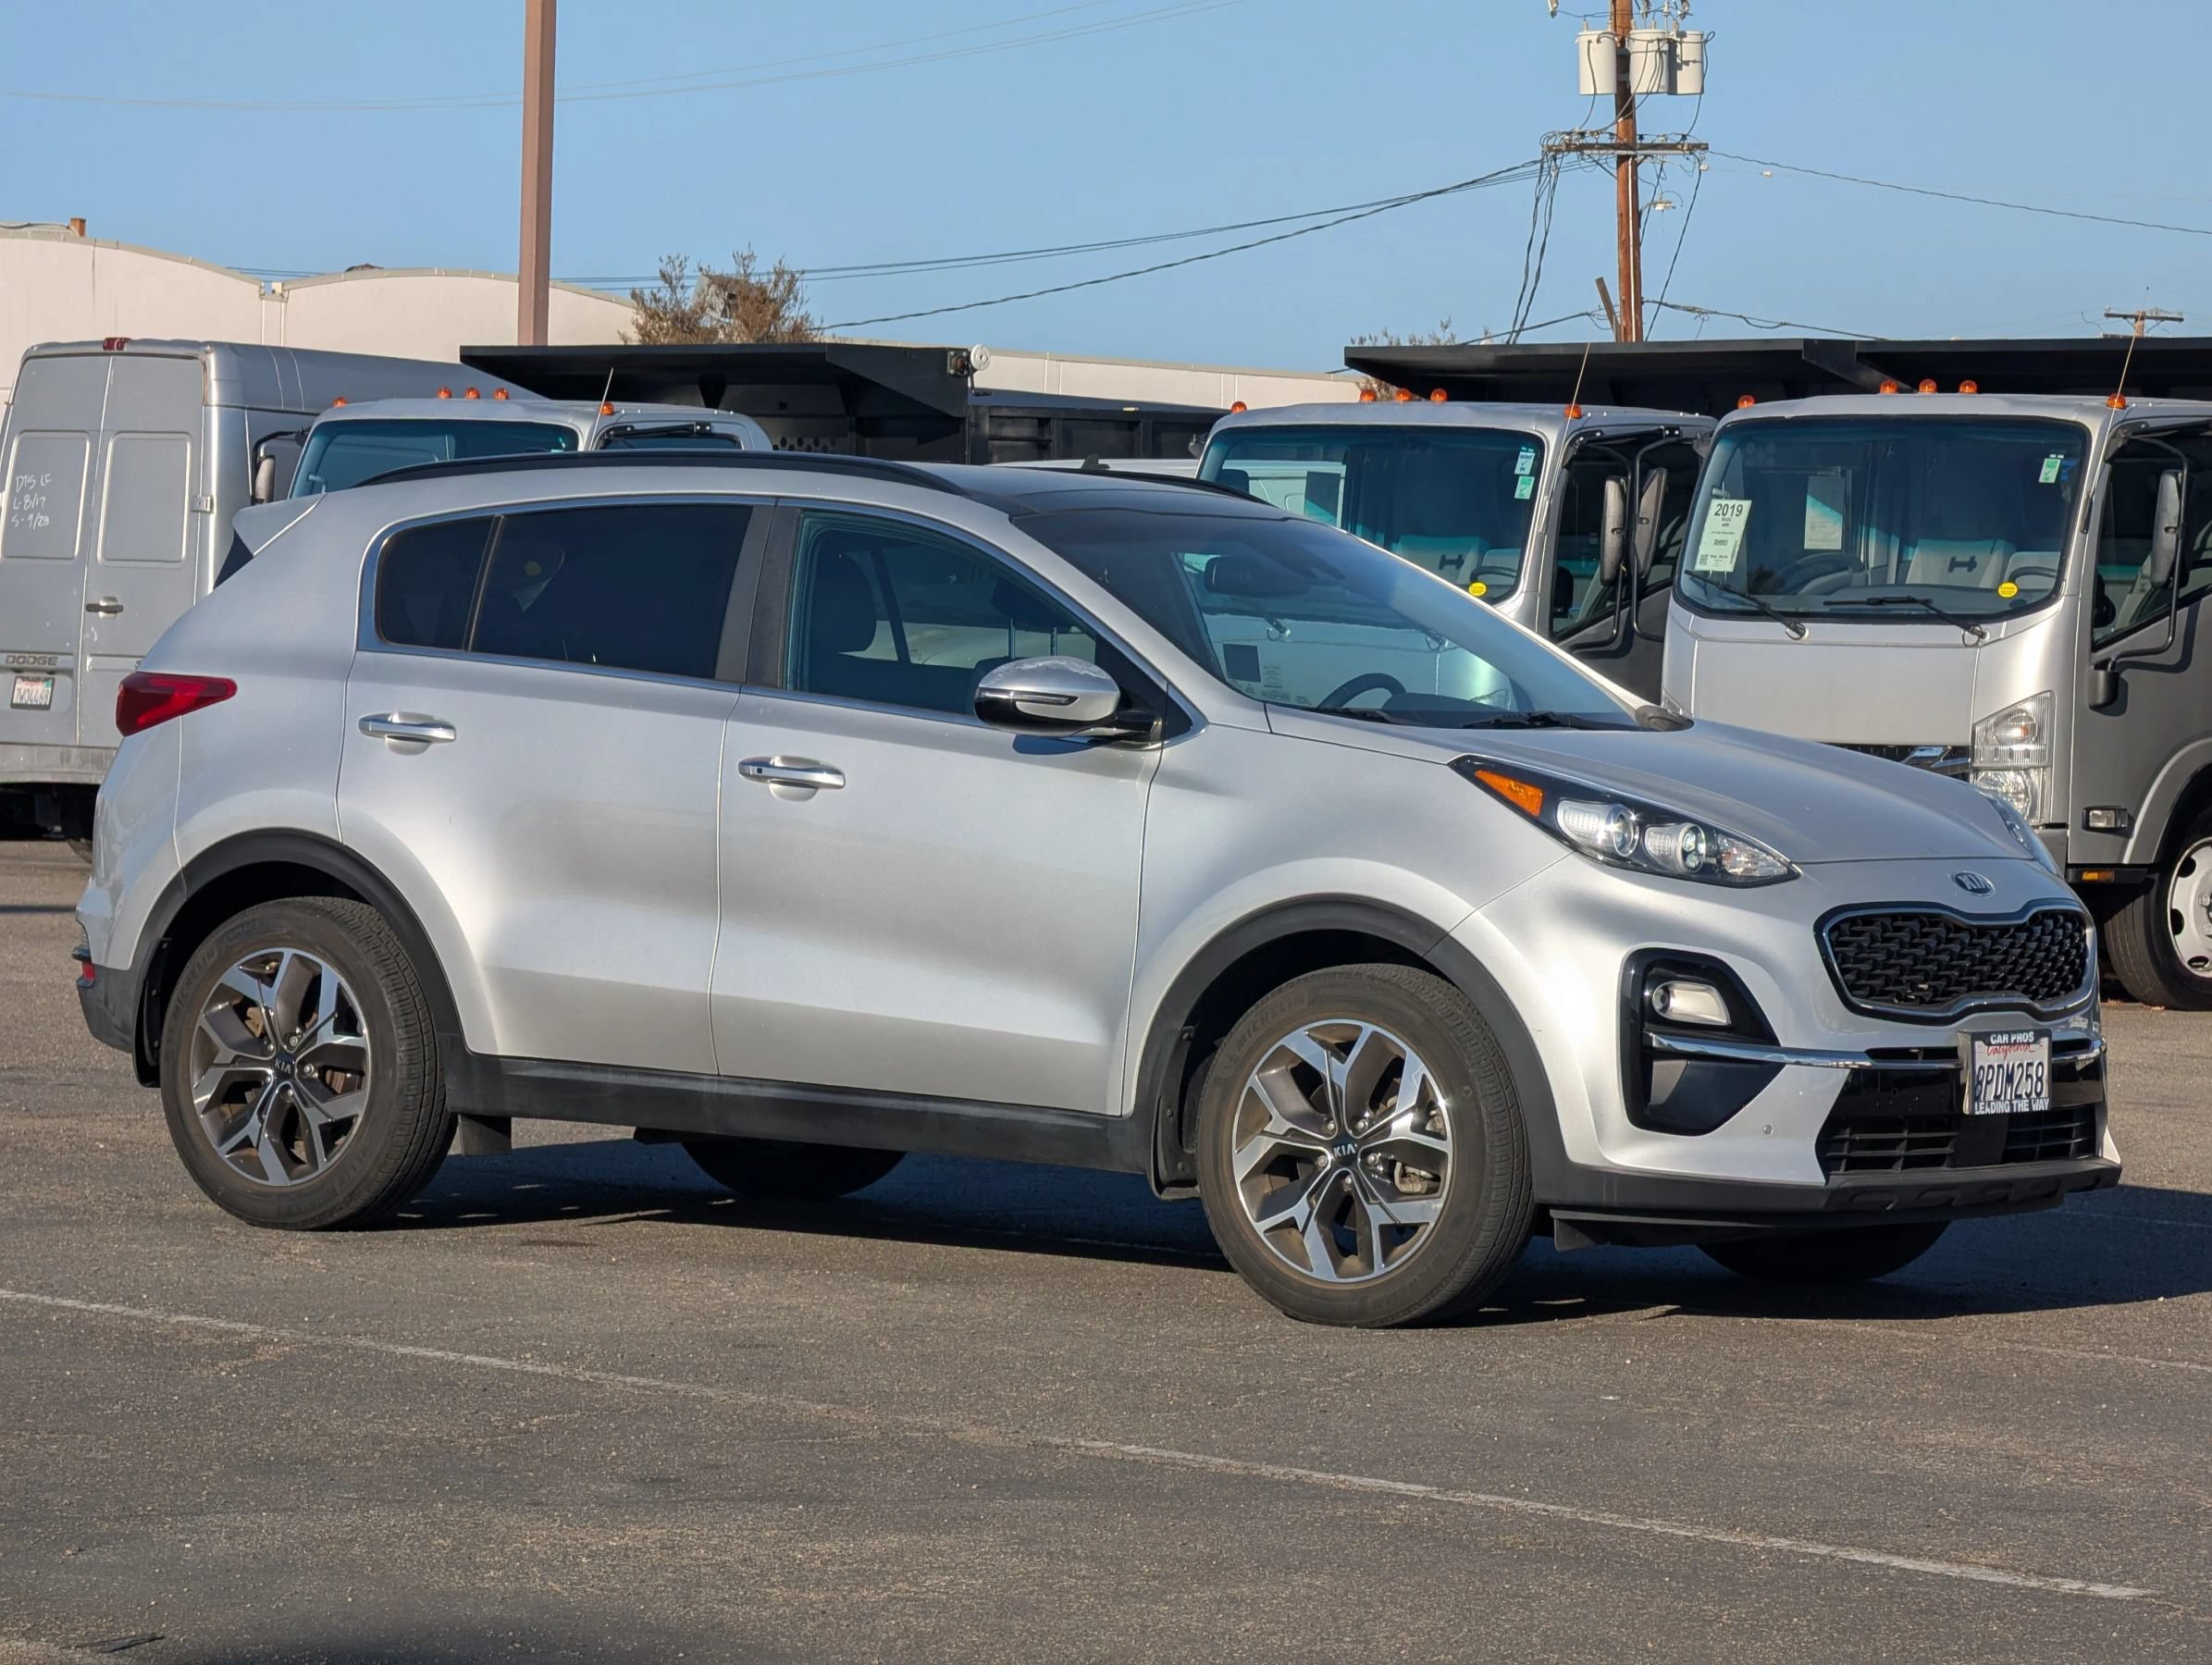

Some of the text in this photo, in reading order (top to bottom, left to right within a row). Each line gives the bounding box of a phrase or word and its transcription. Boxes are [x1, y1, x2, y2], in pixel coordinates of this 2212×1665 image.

[1713, 502, 1743, 517] 2019
[6, 654, 58, 666] DODGE
[1957, 874, 1991, 890] KIA
[1990, 1030, 2034, 1044] CAR PROS
[275, 1058, 291, 1074] KIA
[1974, 1061, 2045, 1102] 8PDM258
[1974, 1097, 2049, 1115] LEADING THE WAY
[1333, 1143, 1356, 1157] KIA
